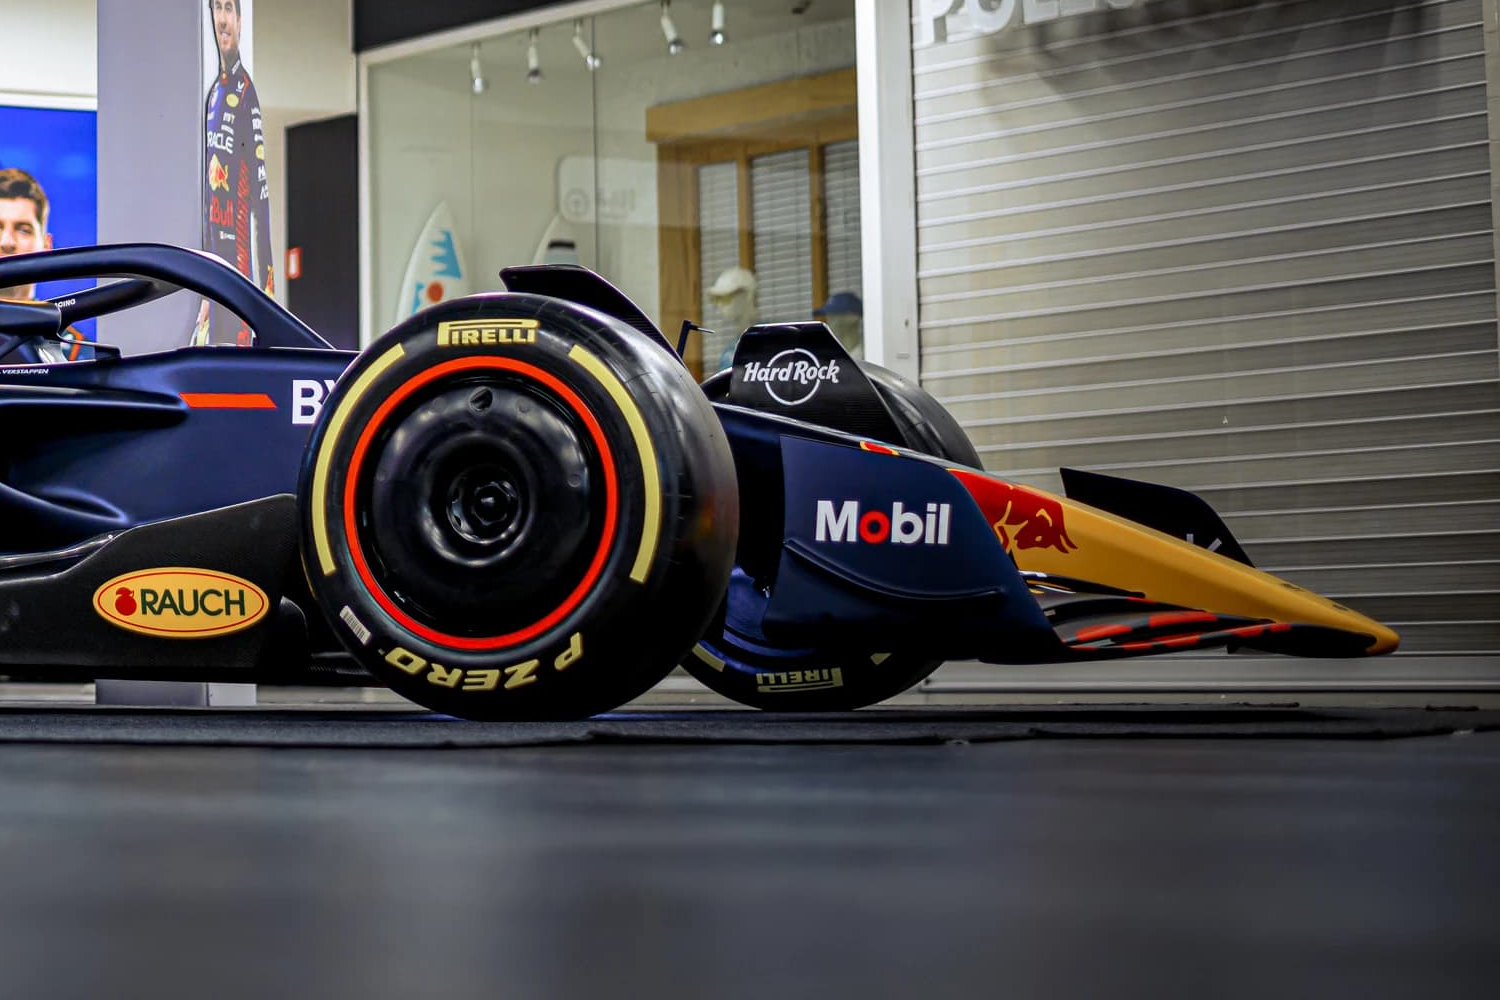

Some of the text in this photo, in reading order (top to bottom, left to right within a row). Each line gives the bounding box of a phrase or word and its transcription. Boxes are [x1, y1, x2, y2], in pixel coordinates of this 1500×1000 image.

[437, 319, 540, 346] PIRELLI
[743, 359, 840, 385] Hard Rock
[815, 499, 951, 545] Mobil
[141, 589, 246, 617] RAUCH
[384, 631, 585, 692] P ZERO
[756, 667, 844, 693] PIRELLI
